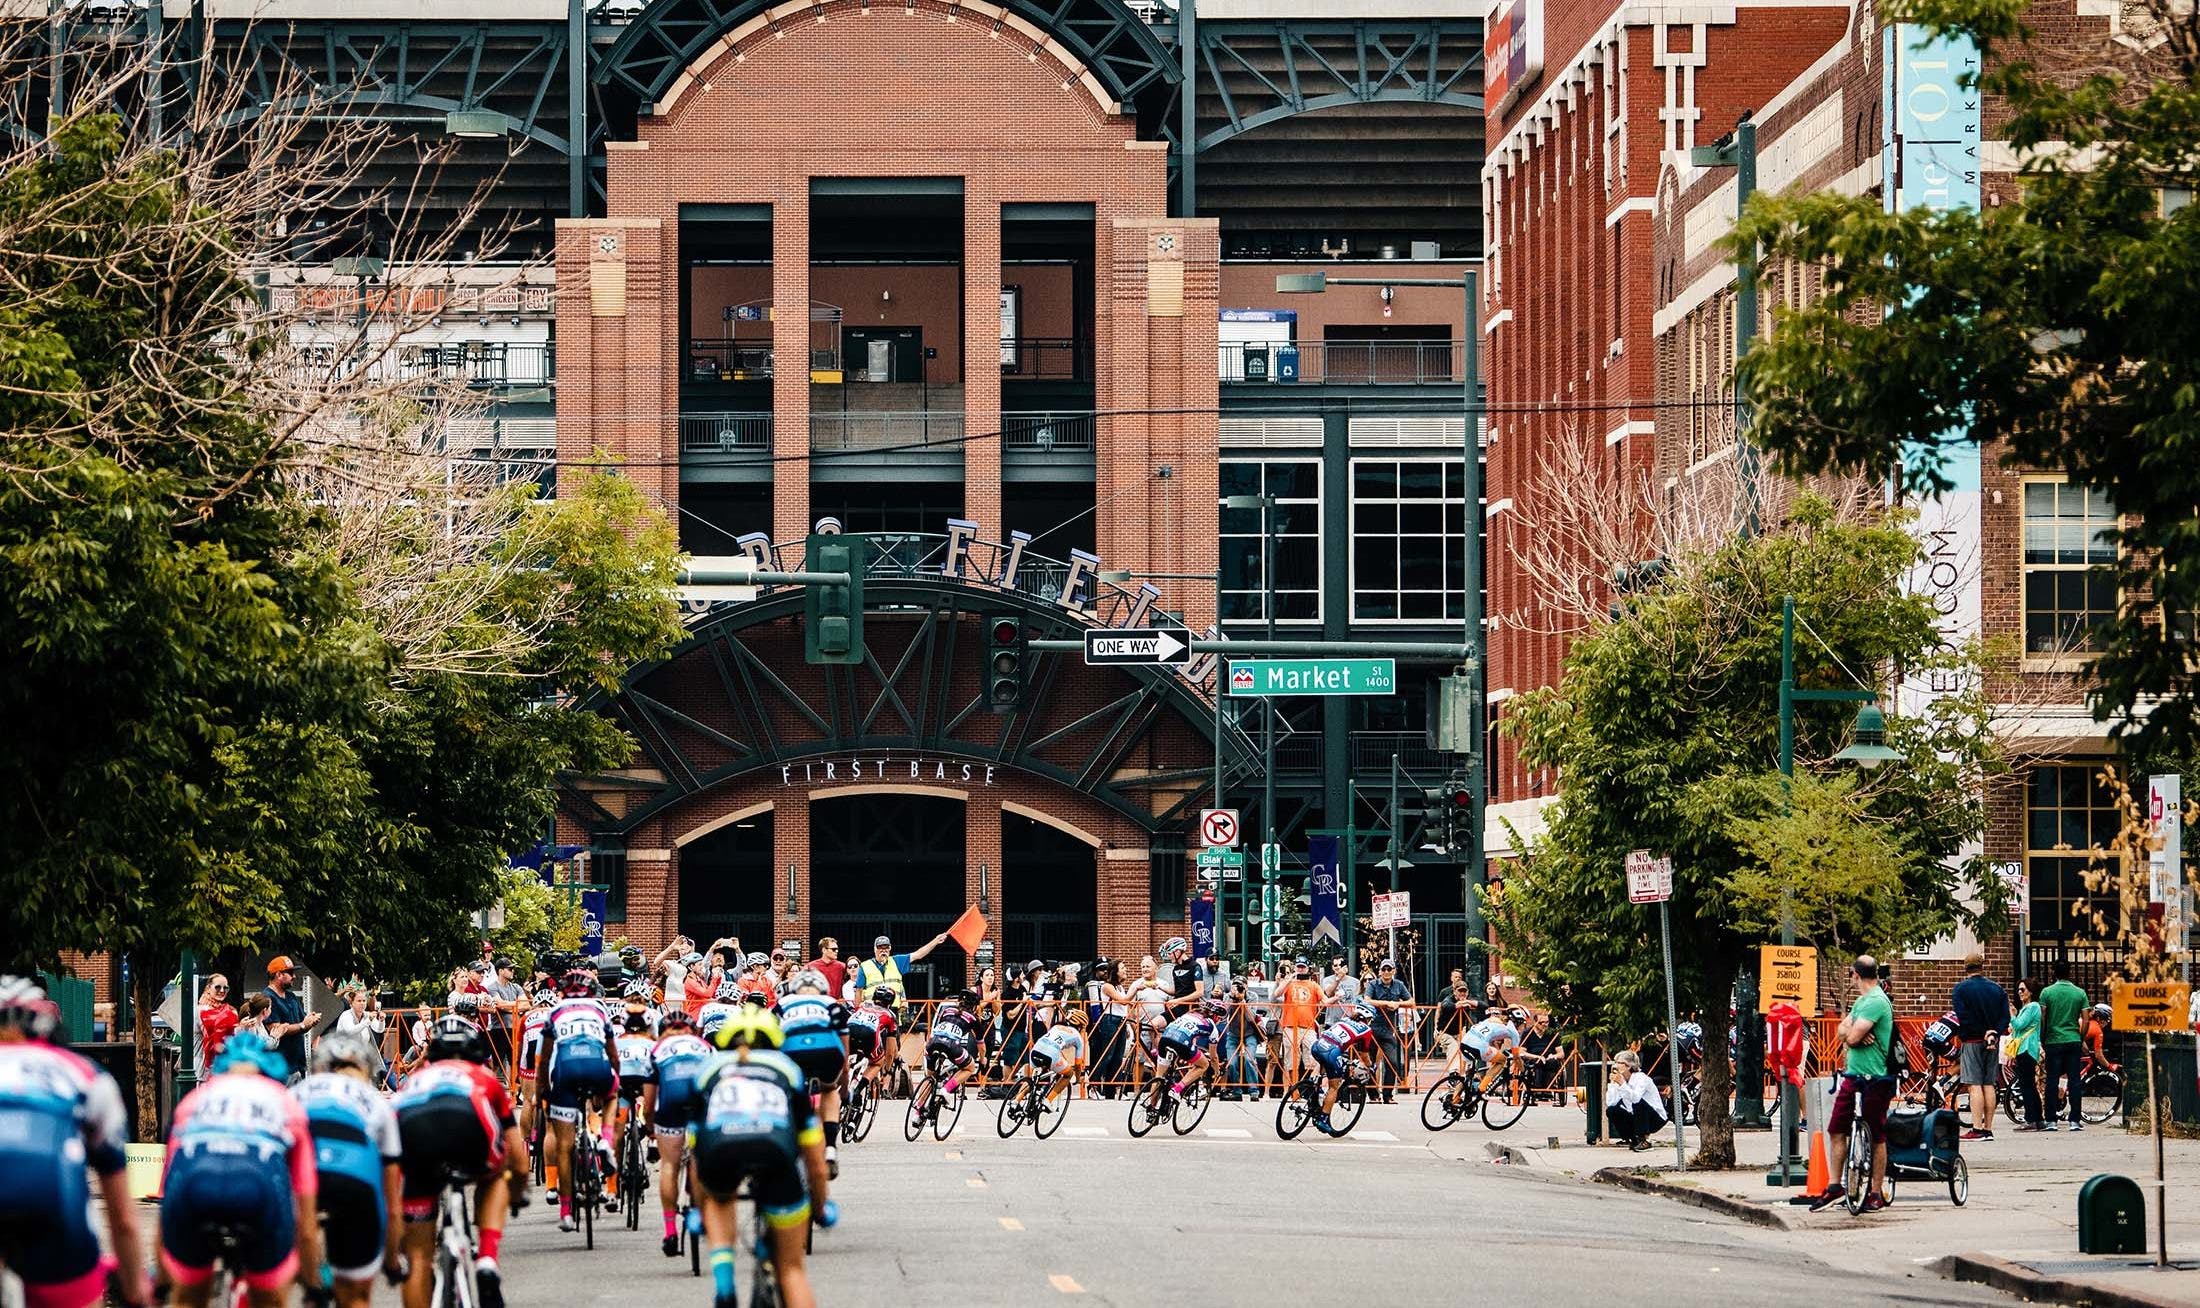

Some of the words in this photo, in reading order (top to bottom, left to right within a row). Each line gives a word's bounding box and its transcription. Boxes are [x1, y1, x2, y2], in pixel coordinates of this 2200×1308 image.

[1965, 58, 1976, 184] MARKET
[1097, 640, 1125, 653] ONE
[1130, 640, 1158, 653] WAY
[1372, 666, 1382, 676] St
[1267, 666, 1350, 689] Market
[1365, 677, 1390, 687] 1400
[782, 761, 885, 784] FIRST
[911, 761, 994, 783] BASE
[1635, 853, 1649, 863] NO
[1629, 863, 1657, 874] PARKING
[1991, 863, 2021, 876] 201
[1776, 949, 1801, 958] COURSE
[1776, 970, 1801, 979] COURSE
[1776, 983, 1801, 992] COURSE
[2134, 986, 2167, 998] COURSE
[2134, 1016, 2167, 1026] COURSE
